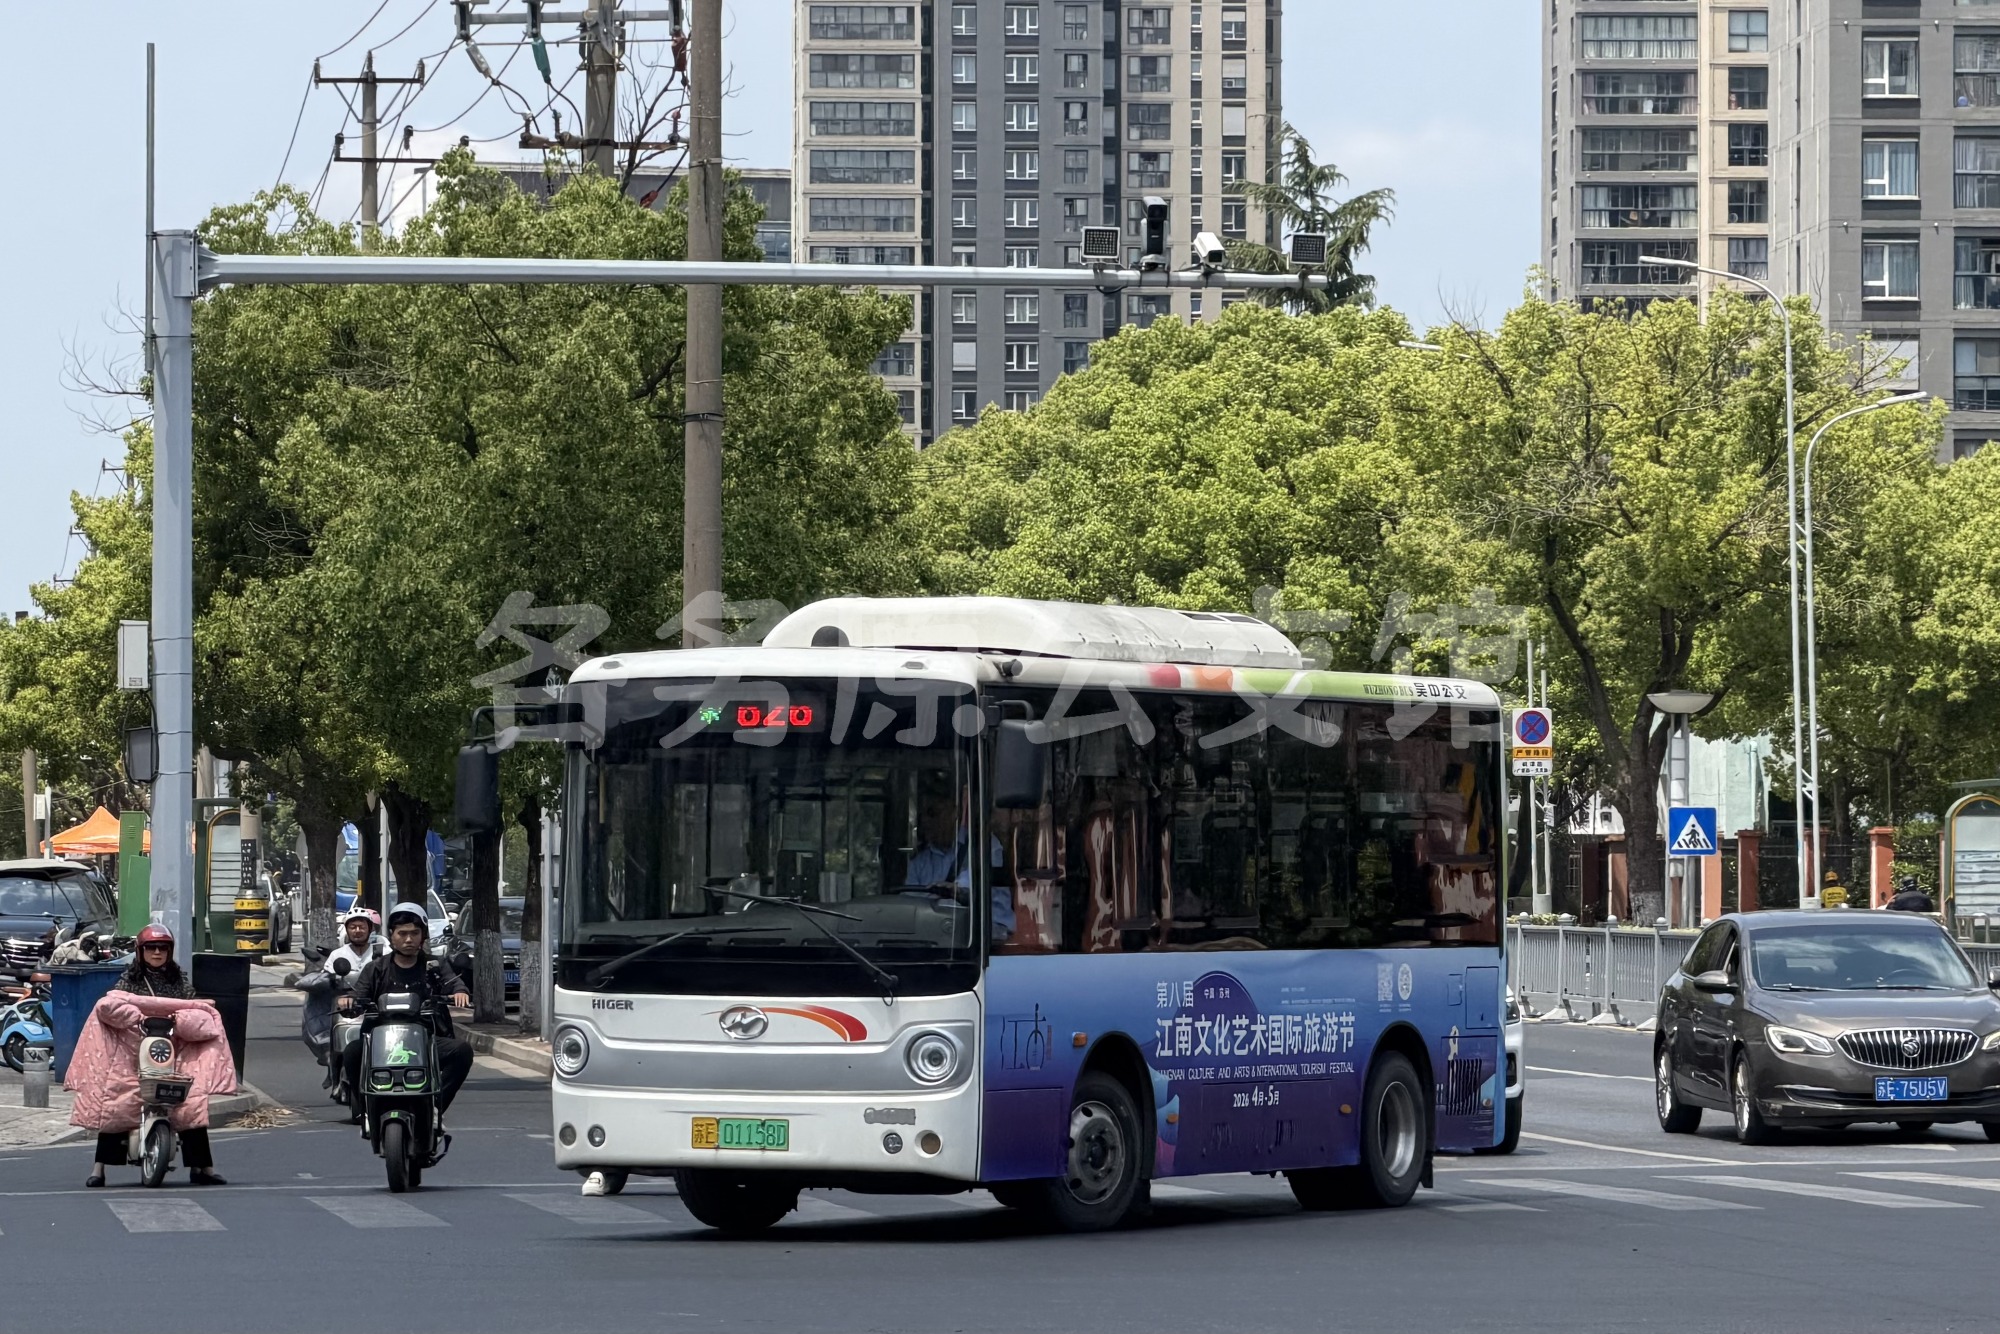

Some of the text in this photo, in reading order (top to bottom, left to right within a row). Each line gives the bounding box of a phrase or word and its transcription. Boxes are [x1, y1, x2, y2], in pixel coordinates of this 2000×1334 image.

[1413, 682, 1468, 699] 吴中公交
[1156, 981, 1194, 1008] 第八届
[592, 998, 634, 1011] HIGER
[1188, 1067, 1215, 1081] CULTURE
[1218, 1066, 1231, 1079] AND
[1234, 1066, 1250, 1079] ARTS
[1301, 1062, 1326, 1075] TOURISM
[1329, 1061, 1355, 1074] FESTIVAL
[1233, 1093, 1249, 1107] 2026
